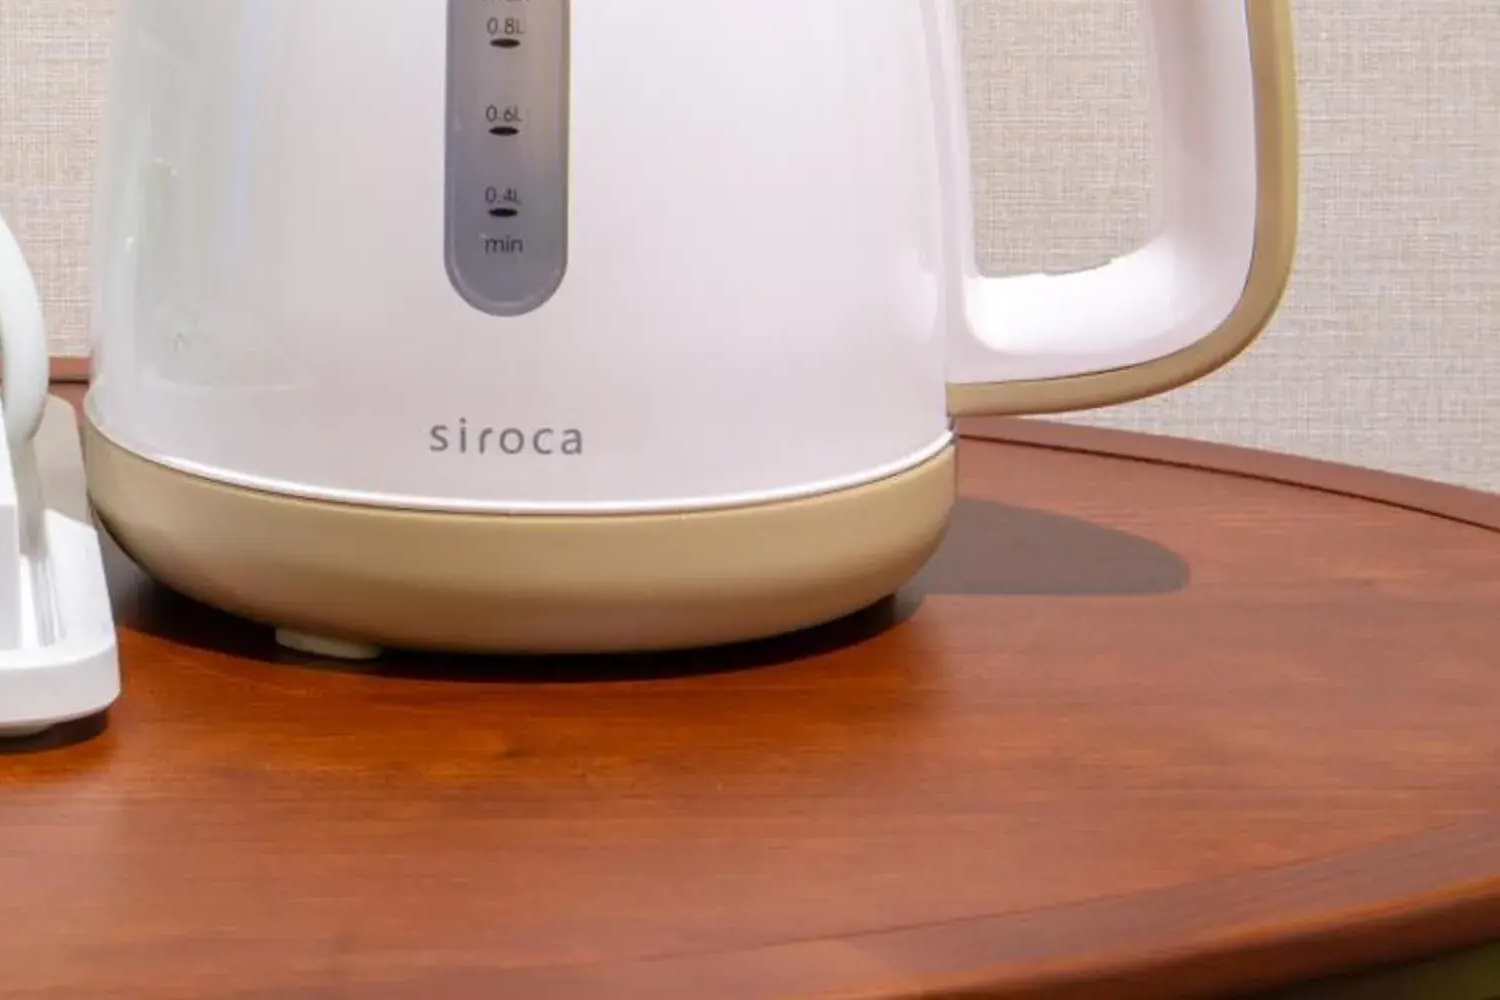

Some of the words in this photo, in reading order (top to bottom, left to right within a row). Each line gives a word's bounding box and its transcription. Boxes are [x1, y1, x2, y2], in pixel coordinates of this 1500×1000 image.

[486, 16, 527, 36] 0.8L
[485, 104, 523, 122] 0.6L
[484, 186, 522, 206] 0.4L
[484, 235, 524, 254] min
[429, 416, 584, 456] siroca
